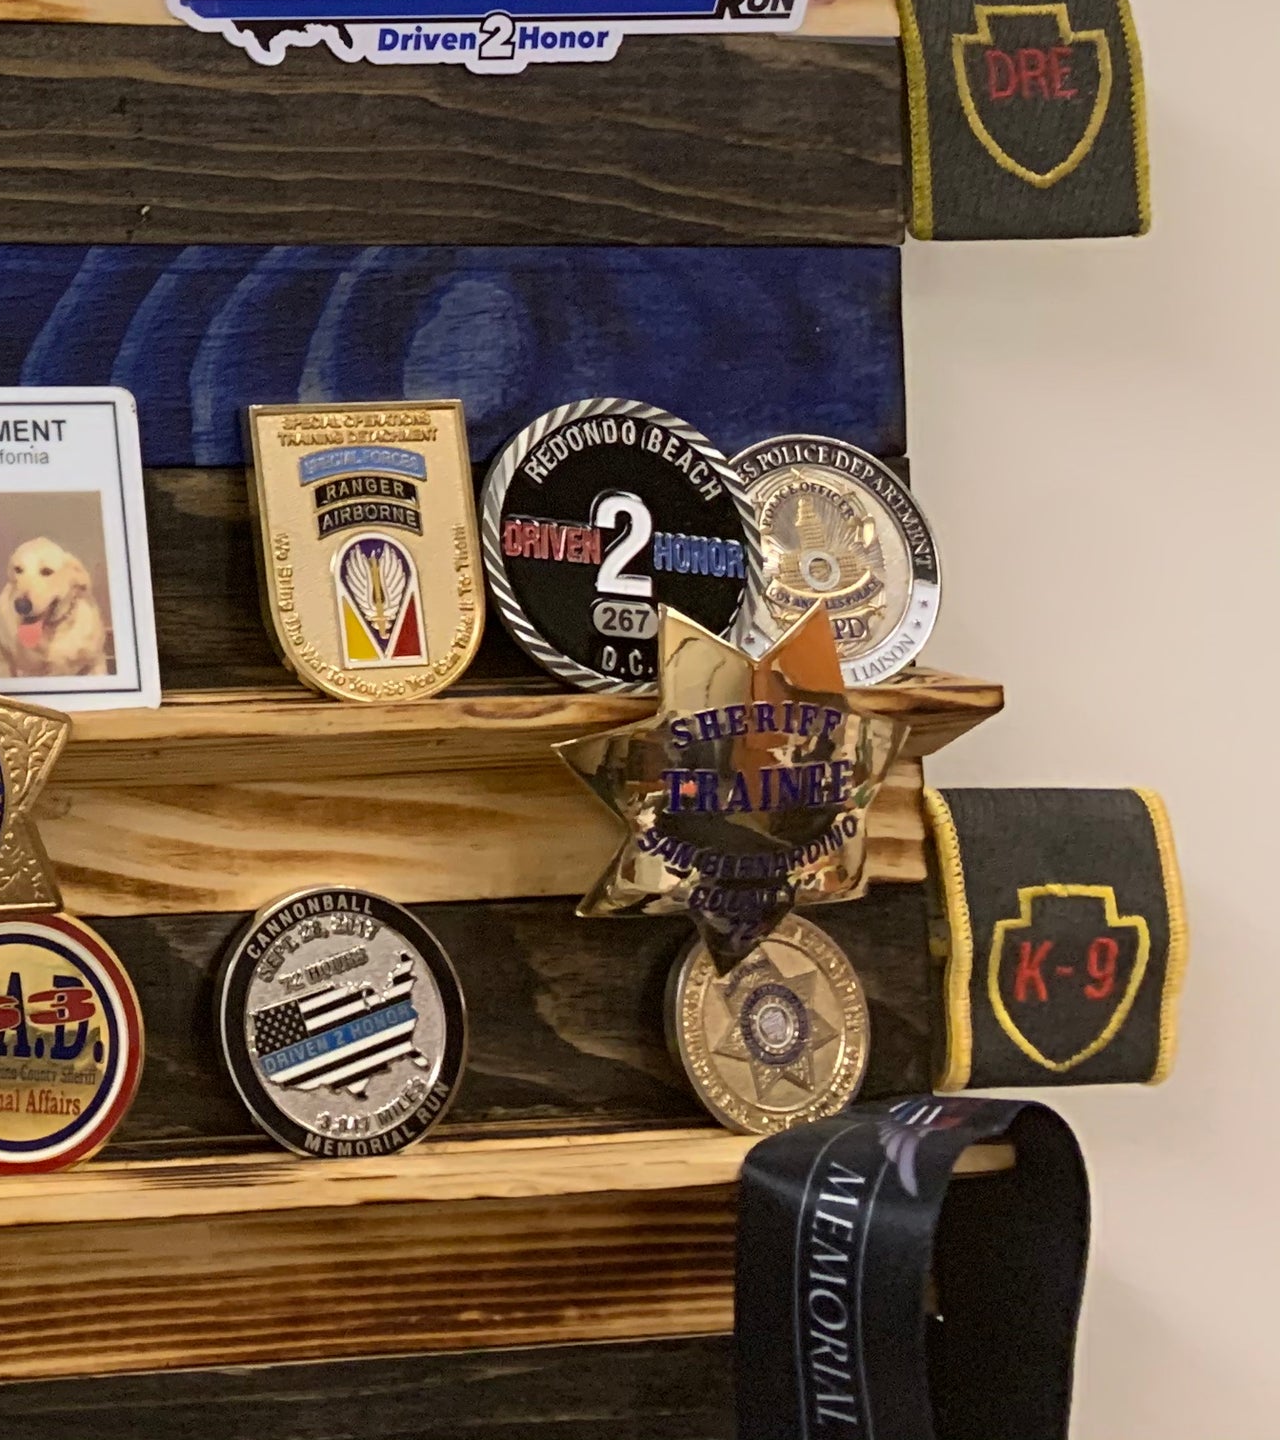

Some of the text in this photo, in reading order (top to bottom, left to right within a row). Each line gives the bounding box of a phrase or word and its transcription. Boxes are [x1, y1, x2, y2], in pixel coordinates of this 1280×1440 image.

[984, 44, 1079, 101] DRE
[325, 479, 405, 499] RANGER
[524, 418, 724, 501] REDONDO BEACH
[321, 504, 418, 531] AIRBORNE
[761, 444, 935, 570] POLICE DEPARTMENT
[501, 492, 747, 597] DRIVEN 2 HONOR
[601, 607, 651, 634] 267
[670, 701, 843, 750] SHERIFF
[661, 760, 853, 814] TRAINEE
[246, 894, 374, 961] CANNONBALL
[1013, 936, 1119, 1002] K-9
[303, 1123, 417, 1157] MEMORIAL
[420, 1082, 450, 1128] RUN
[807, 1160, 866, 1426] MEMORIAL
